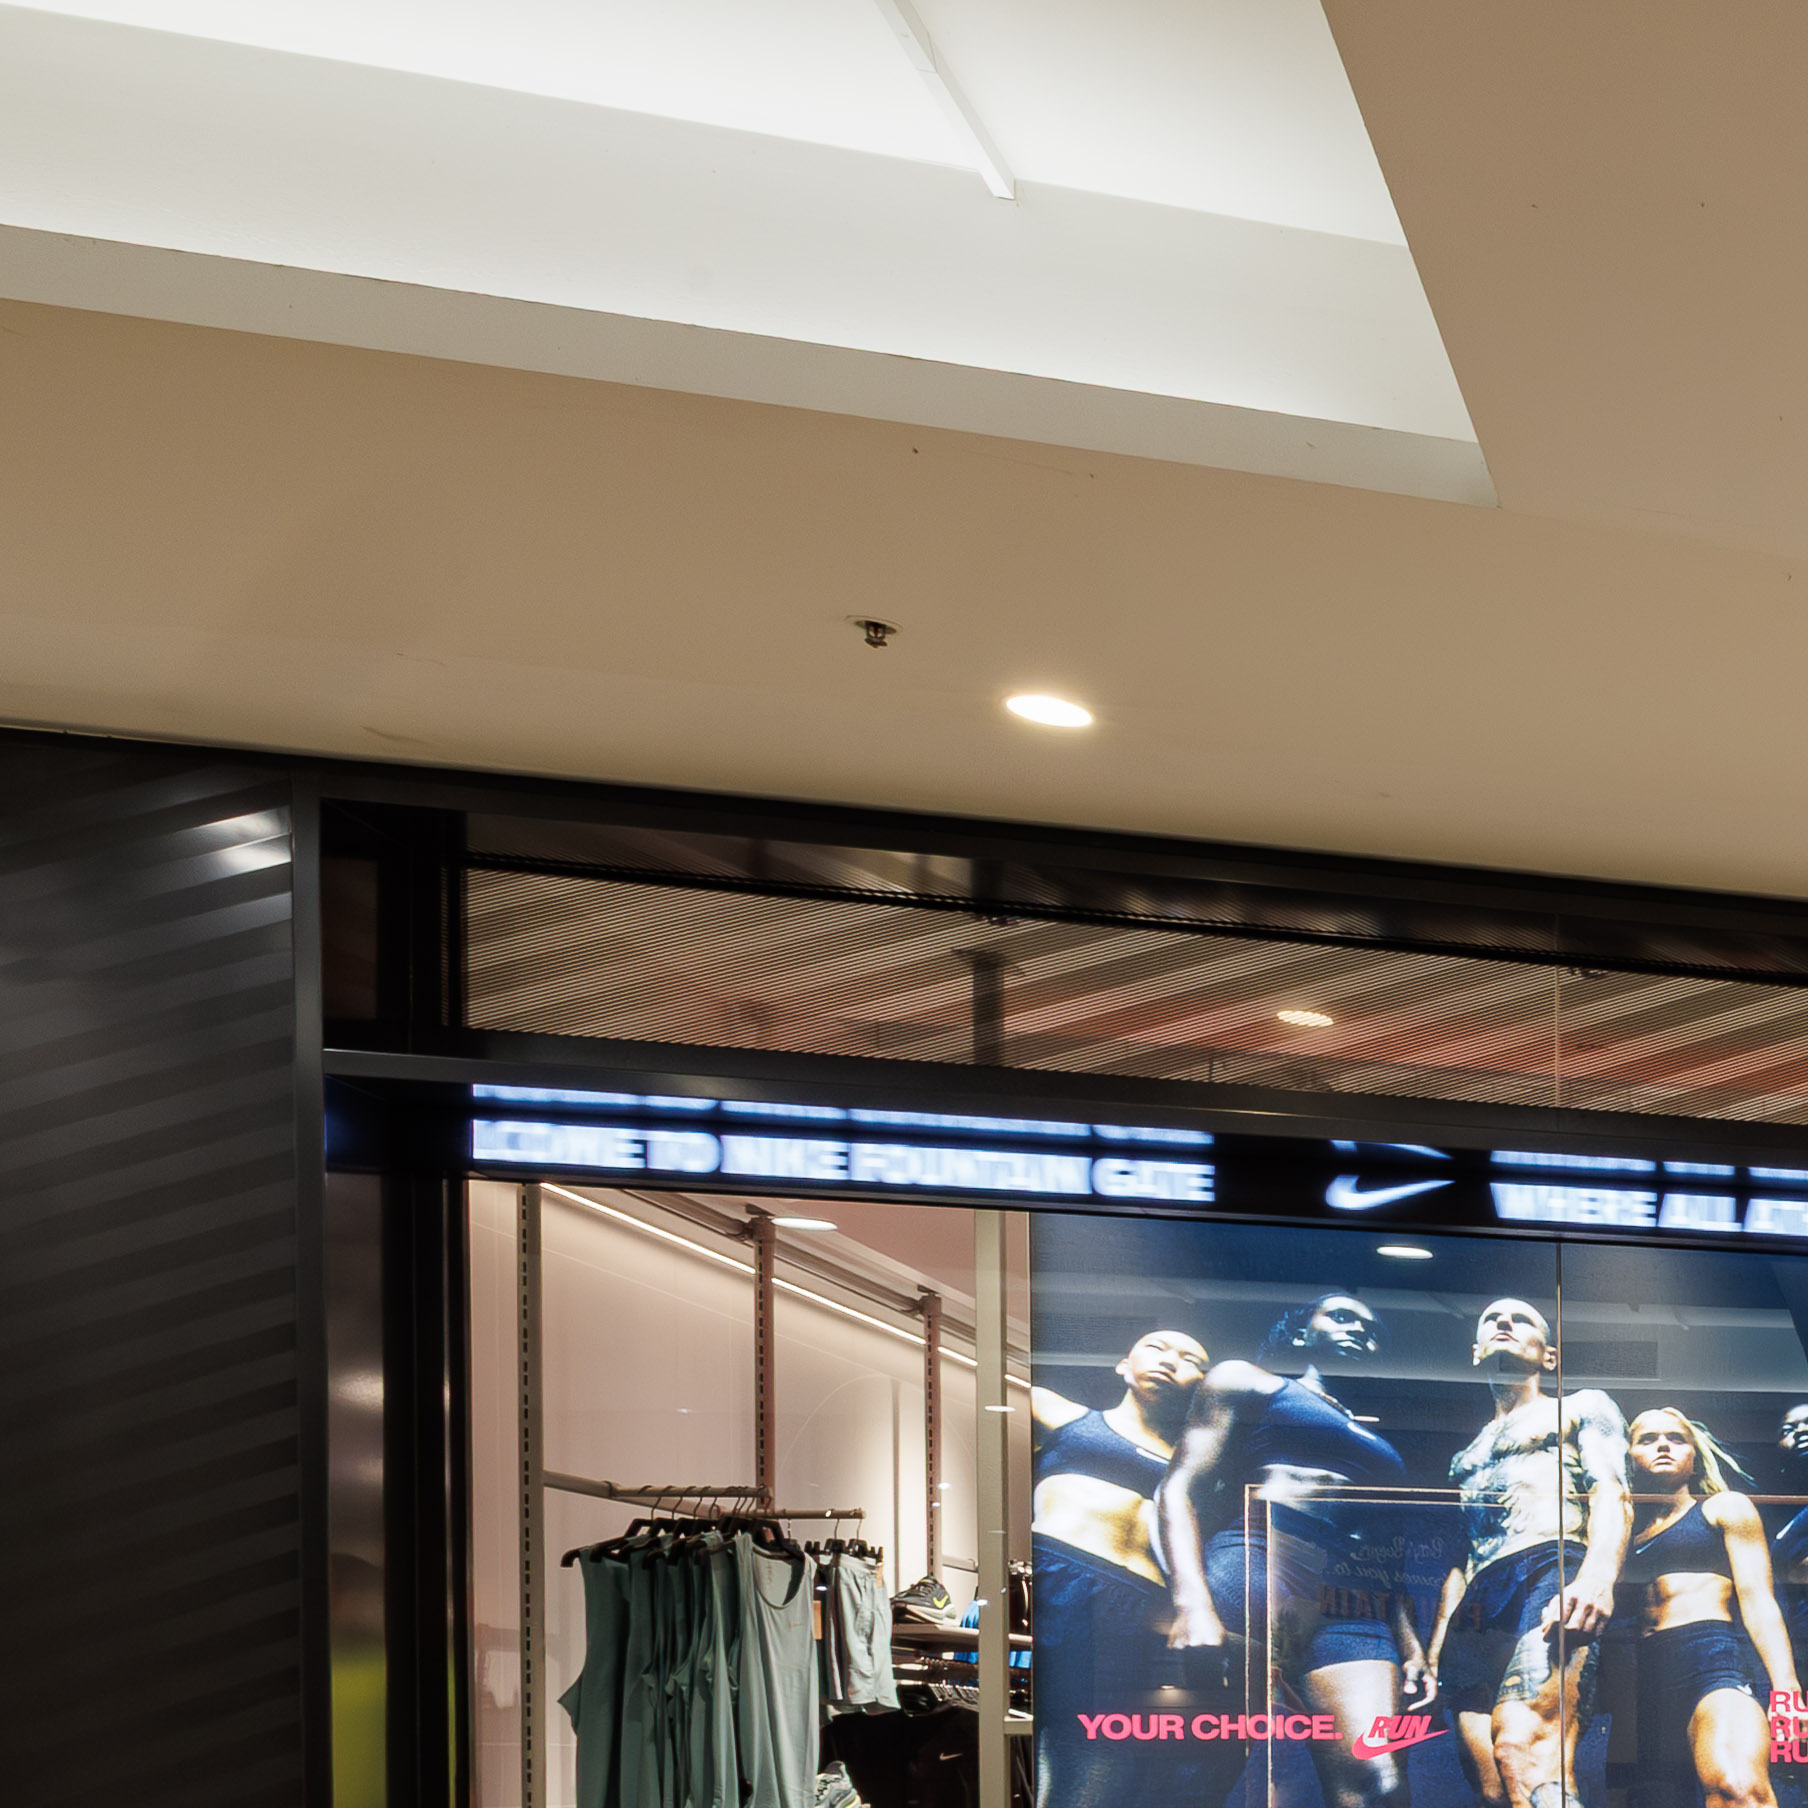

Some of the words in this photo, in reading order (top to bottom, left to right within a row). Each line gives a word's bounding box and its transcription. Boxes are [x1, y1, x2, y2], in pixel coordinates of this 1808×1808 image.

[720, 1134, 849, 1181] NIKE
[850, 1143, 1092, 1195] FOUNTAIN
[1092, 1157, 1215, 1202] GATE
[1489, 1183, 1657, 1228] WHERE
[1657, 1192, 1742, 1232] ALL
[1078, 1714, 1184, 1741] YOUR
[1191, 1714, 1344, 1741] CHOICE.
[1369, 1715, 1433, 1739] RUN
